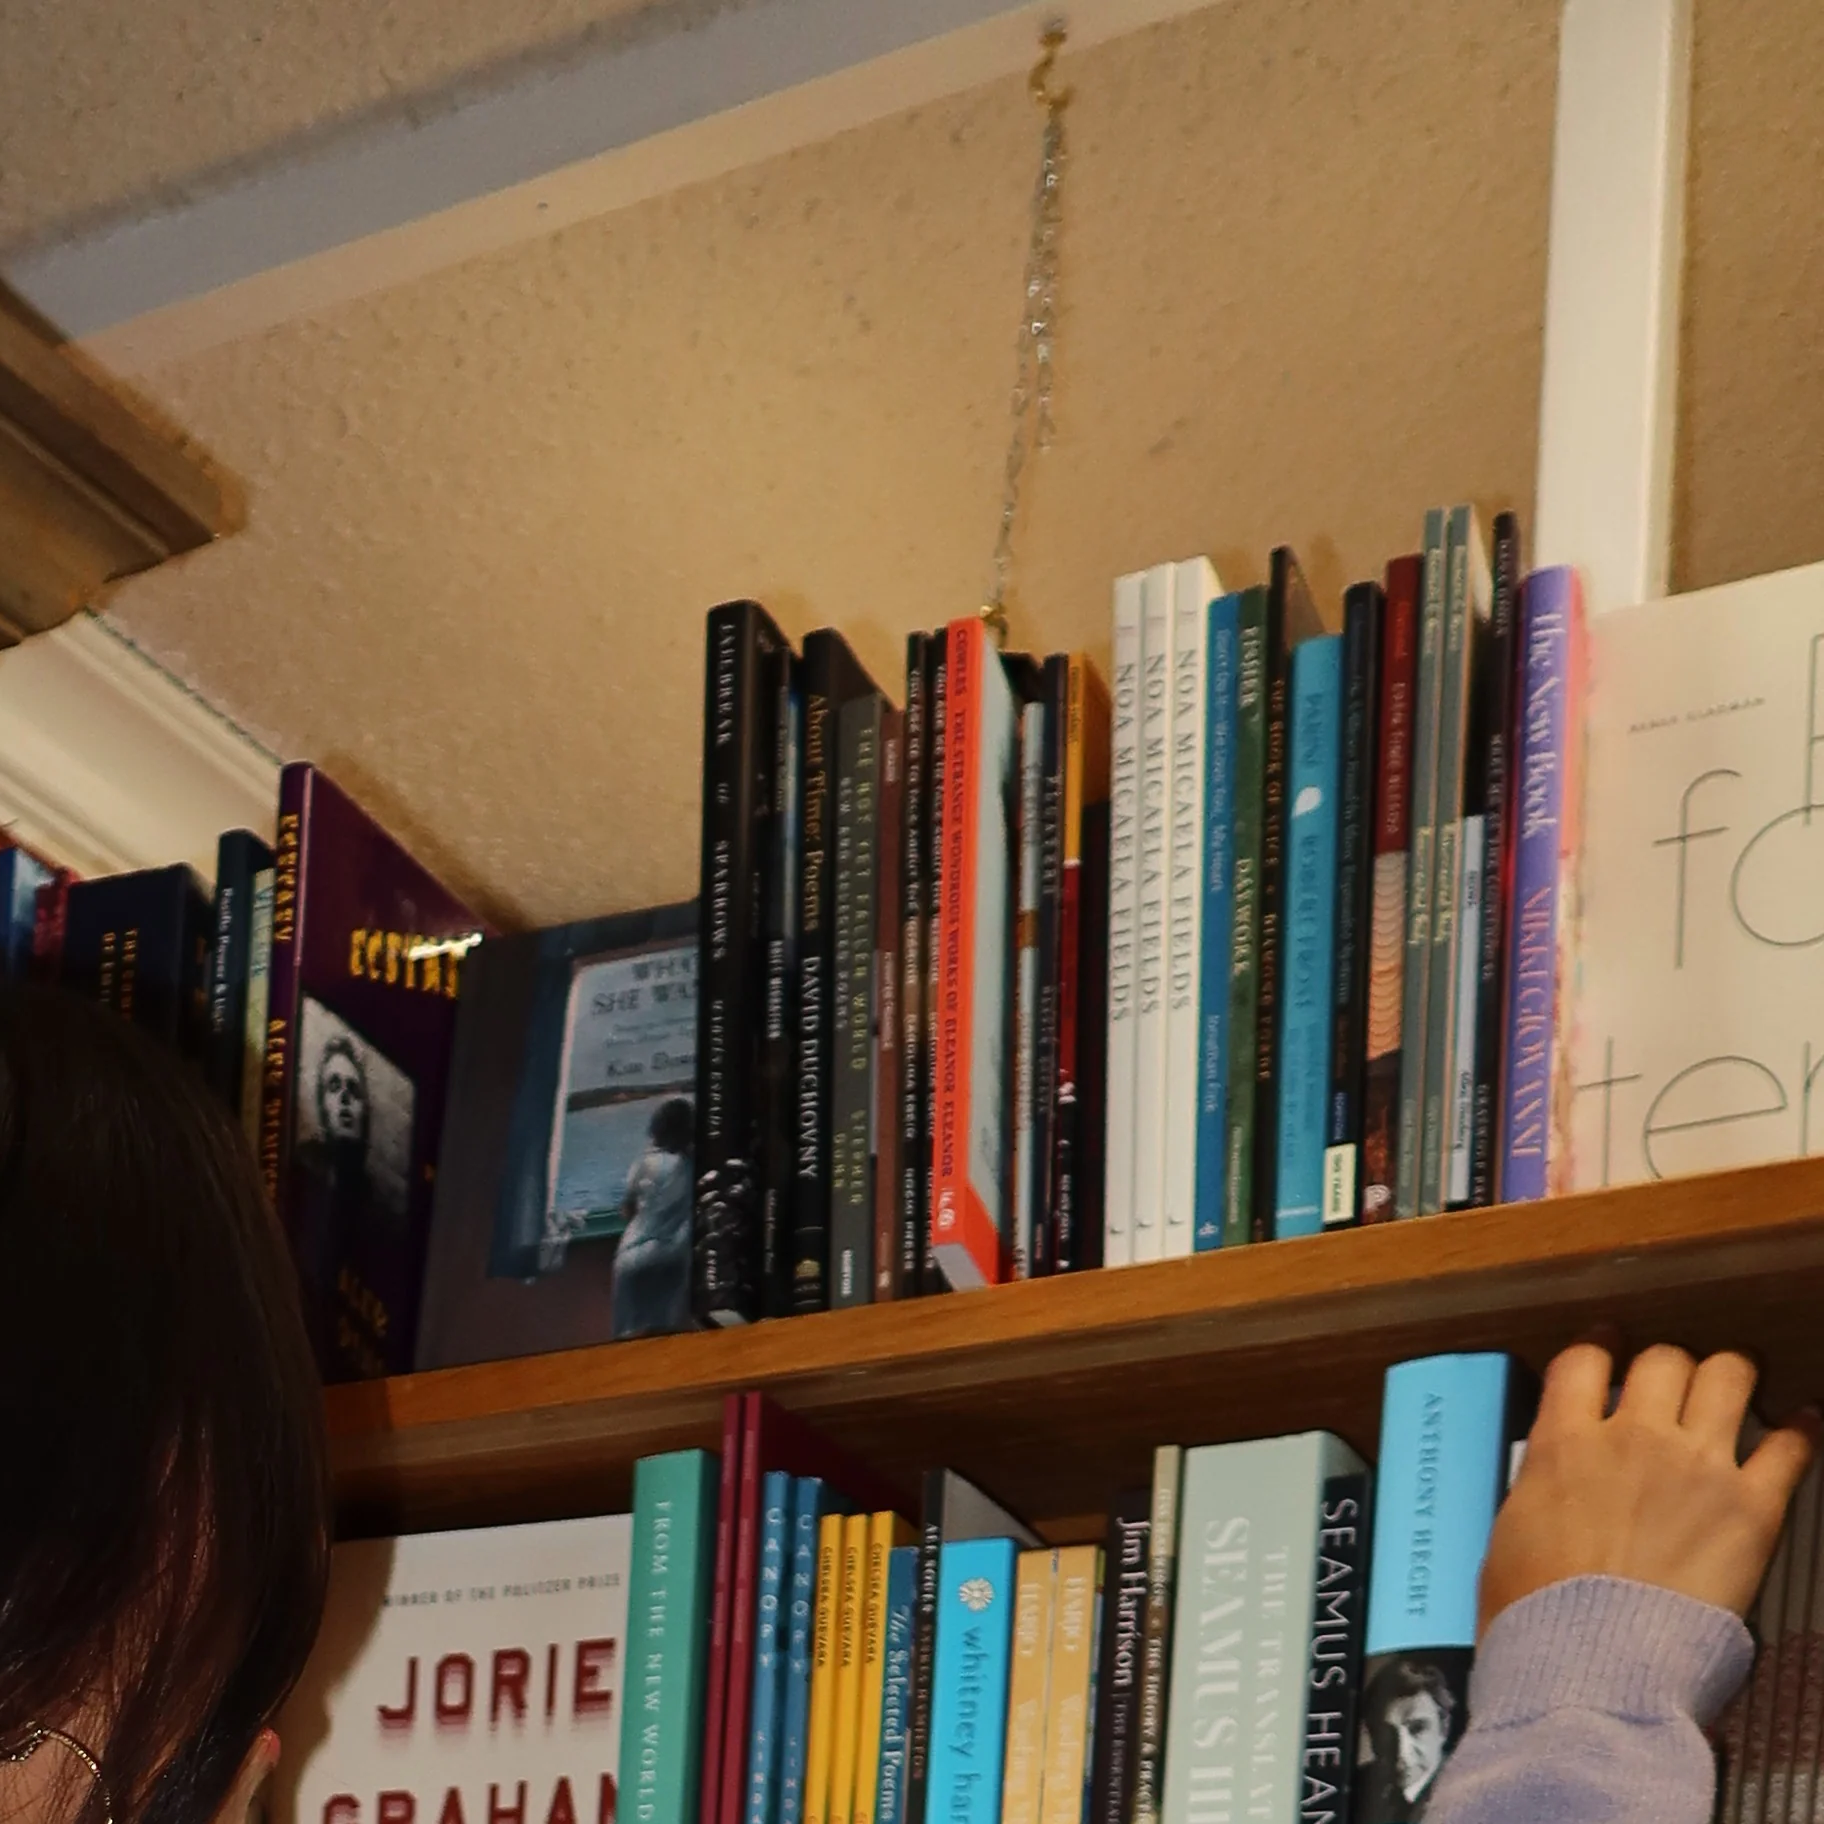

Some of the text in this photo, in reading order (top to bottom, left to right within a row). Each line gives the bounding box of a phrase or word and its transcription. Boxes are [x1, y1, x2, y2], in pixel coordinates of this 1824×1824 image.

[1524, 613, 1568, 838] The New Book
[1111, 664, 1136, 1022] NOA MICAELA FIELDS
[1138, 655, 1166, 1014] NOA MICAELA FIELDS
[1169, 648, 1197, 1010] NOA MICAELA FIELDS
[798, 694, 830, 1180] About Time: Poems DAVID DUCHOVNY
[939, 629, 969, 1178] COWLES THE STRANGE WONDROUS WORKS OF ELEANOR ELEANOR
[1115, 1516, 1152, 1566] Jim
[1404, 1392, 1445, 1618] ANTHONY HECHT
[445, 1589, 465, 1603] OF
[469, 1585, 498, 1601] THE
[502, 1577, 572, 1599] PULITZER
[578, 1573, 623, 1591] PRIZE
[759, 1507, 785, 1668] CANOPY
[791, 1514, 813, 1675] CANOPY
[816, 1547, 832, 1668] CHELSEA GUEVARA
[841, 1547, 859, 1668] CHELSEA GUEVARA
[864, 1543, 884, 1664] CHELSEA GUEVARA
[890, 1604, 911, 1644] The
[1112, 1572, 1149, 1688] Harrison
[1192, 1514, 1253, 1749] SEAMUS
[1261, 1545, 1289, 1619] THE
[1309, 1498, 1358, 1689] SEAMUS
[376, 1638, 618, 1732] JORIE
[636, 1499, 674, 1822] FROM THE NEW WORLD
[884, 1649, 909, 1743] Selected
[949, 1625, 991, 1758] whitney
[1143, 1675, 1161, 1734] THEORY
[1148, 1638, 1164, 1670] THE
[1113, 1705, 1129, 1737] THE
[1141, 1740, 1157, 1756] &
[879, 1749, 904, 1821] Poems
